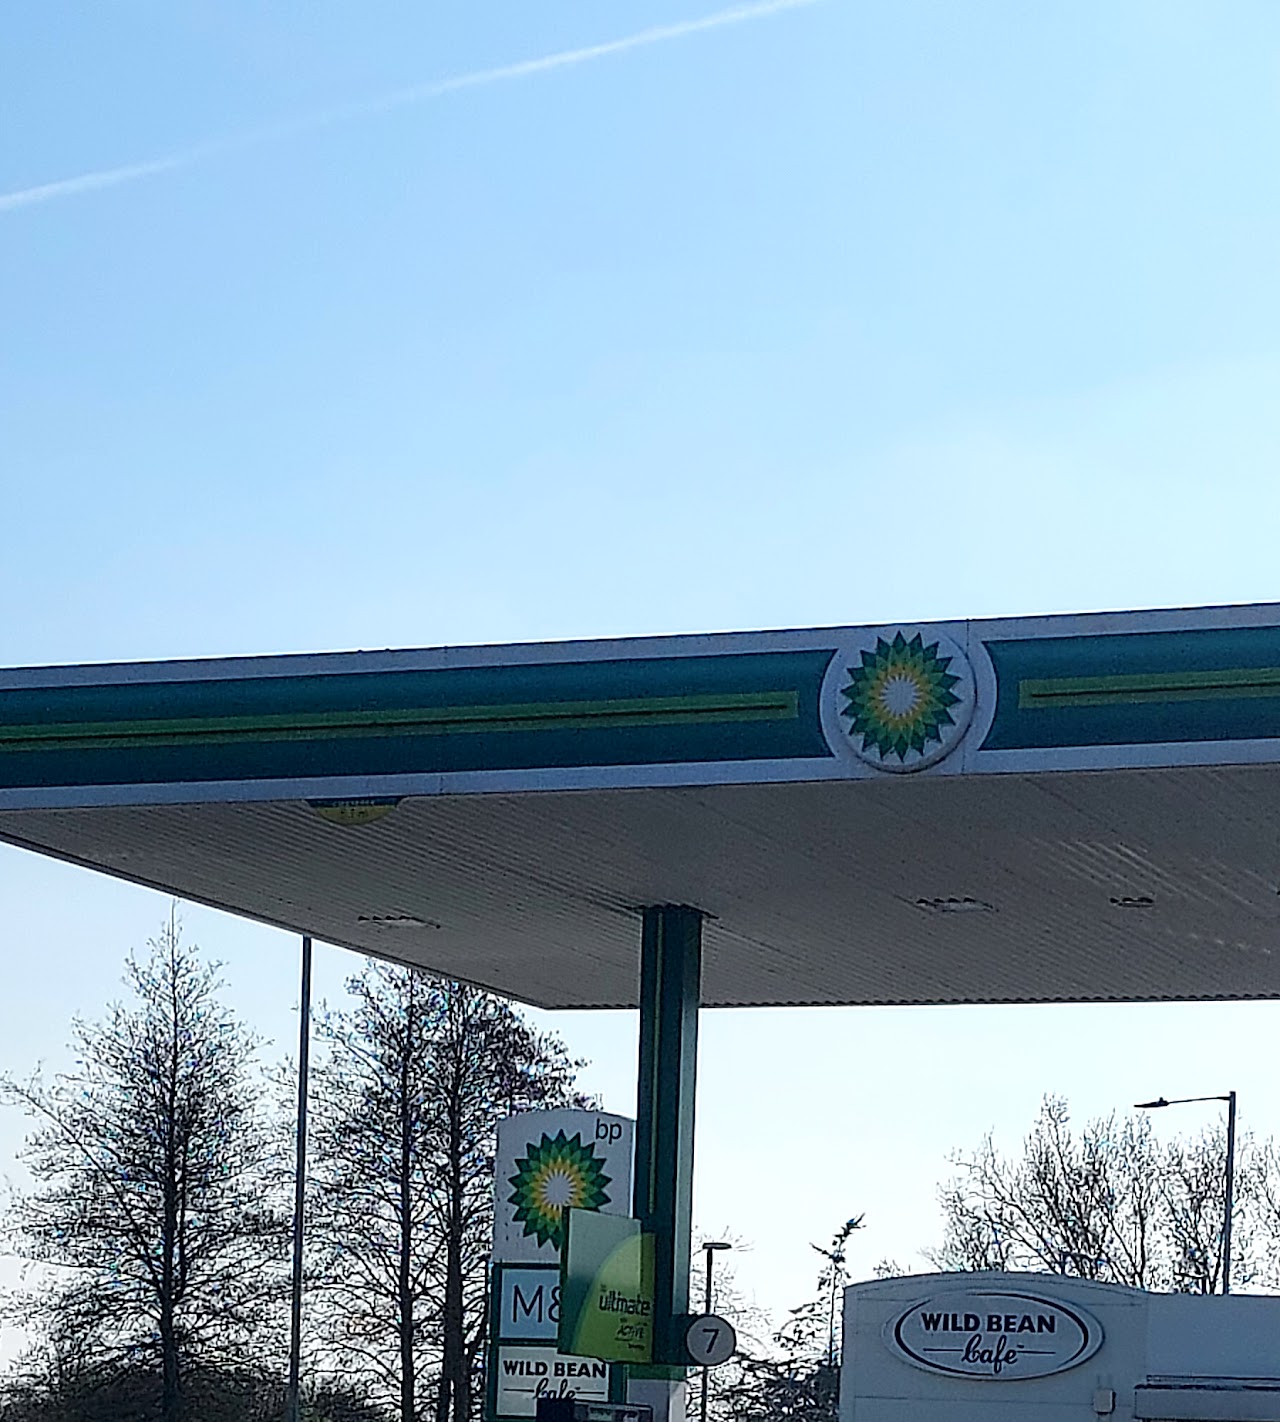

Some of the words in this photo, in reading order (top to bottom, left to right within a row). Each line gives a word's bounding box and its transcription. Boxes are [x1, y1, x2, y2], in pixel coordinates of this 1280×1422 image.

[595, 1118, 622, 1144] bp
[921, 1313, 980, 1332] WILD
[986, 1314, 1055, 1334] BEAN
[702, 1328, 720, 1354] 7
[503, 1360, 547, 1377] WILD
[554, 1361, 606, 1378] BEAN
